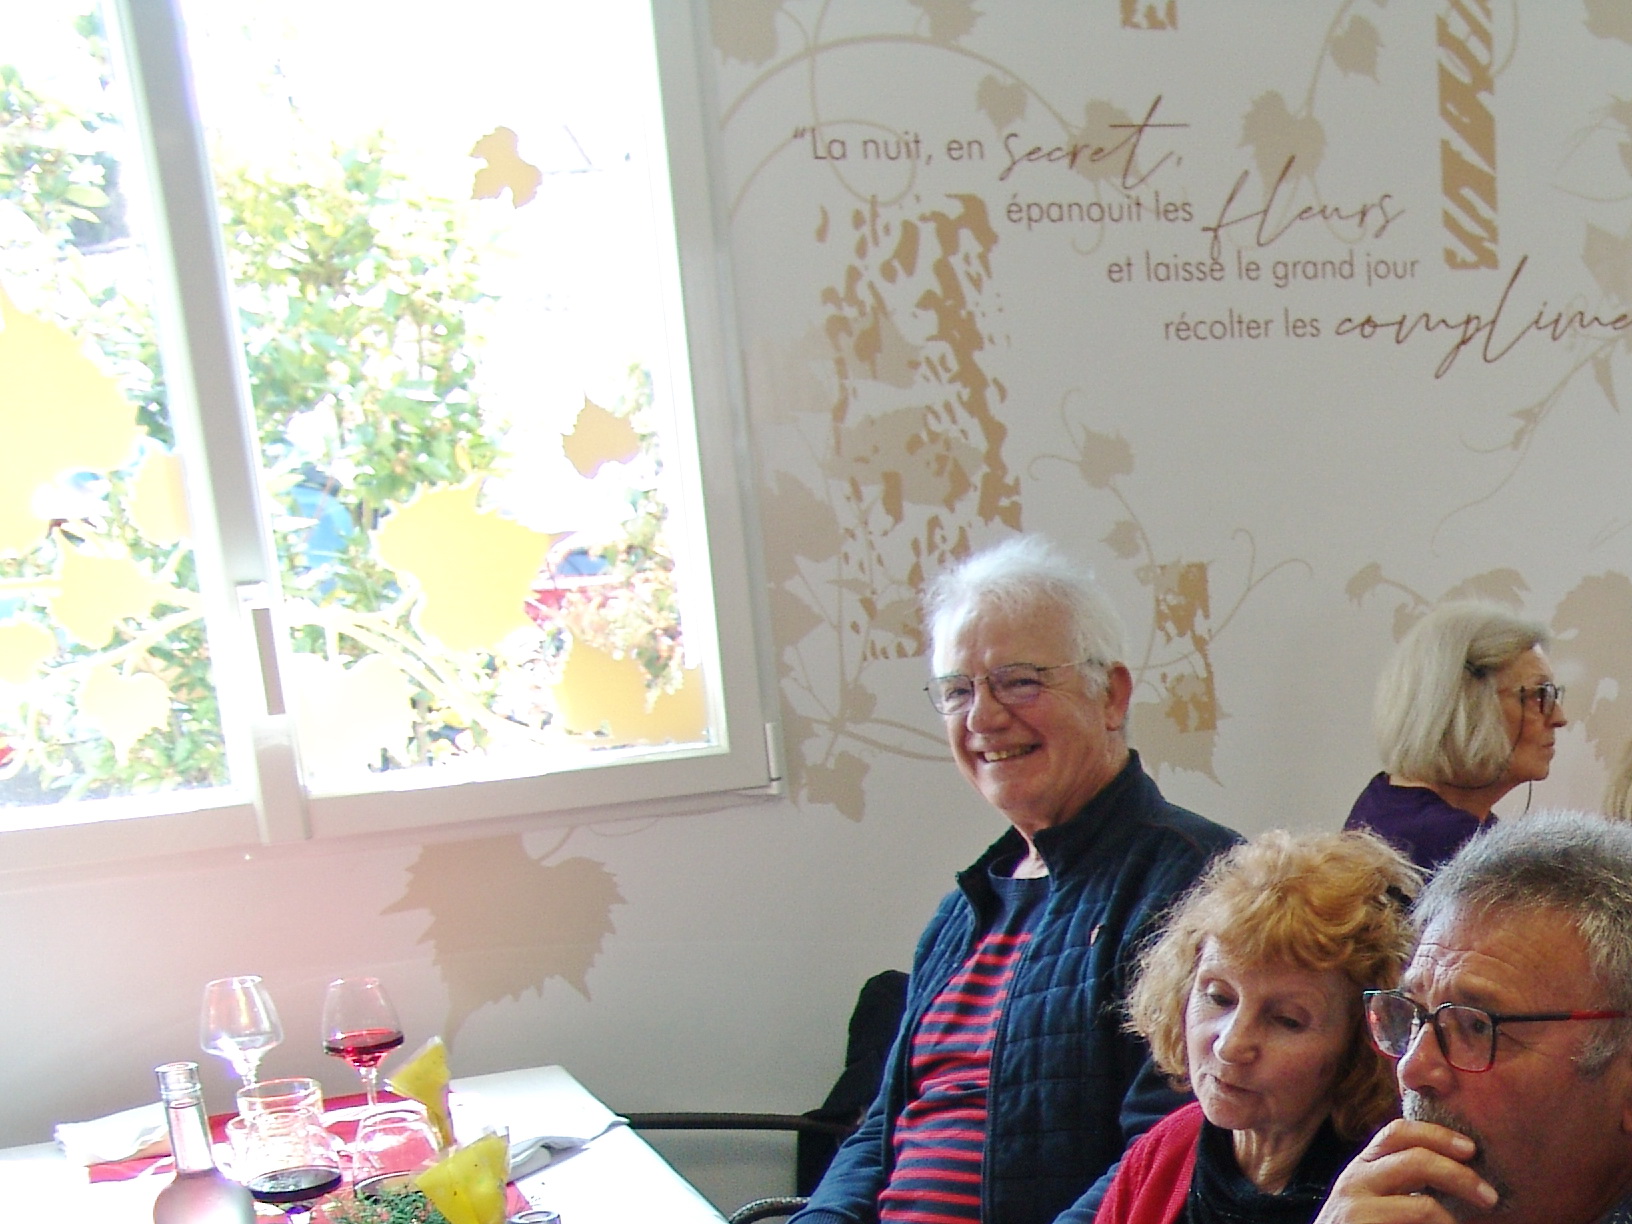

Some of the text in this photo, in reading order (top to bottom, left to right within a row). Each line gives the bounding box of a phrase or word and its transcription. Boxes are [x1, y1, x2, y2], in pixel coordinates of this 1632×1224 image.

[860, 131, 933, 166] nuit,
[946, 142, 986, 161] en
[1006, 153, 1405, 261] épanouit les fleurs
[1107, 249, 1420, 288] et laisse le grand jour
[1164, 308, 1275, 342] récolter
[1283, 307, 1322, 339] les
